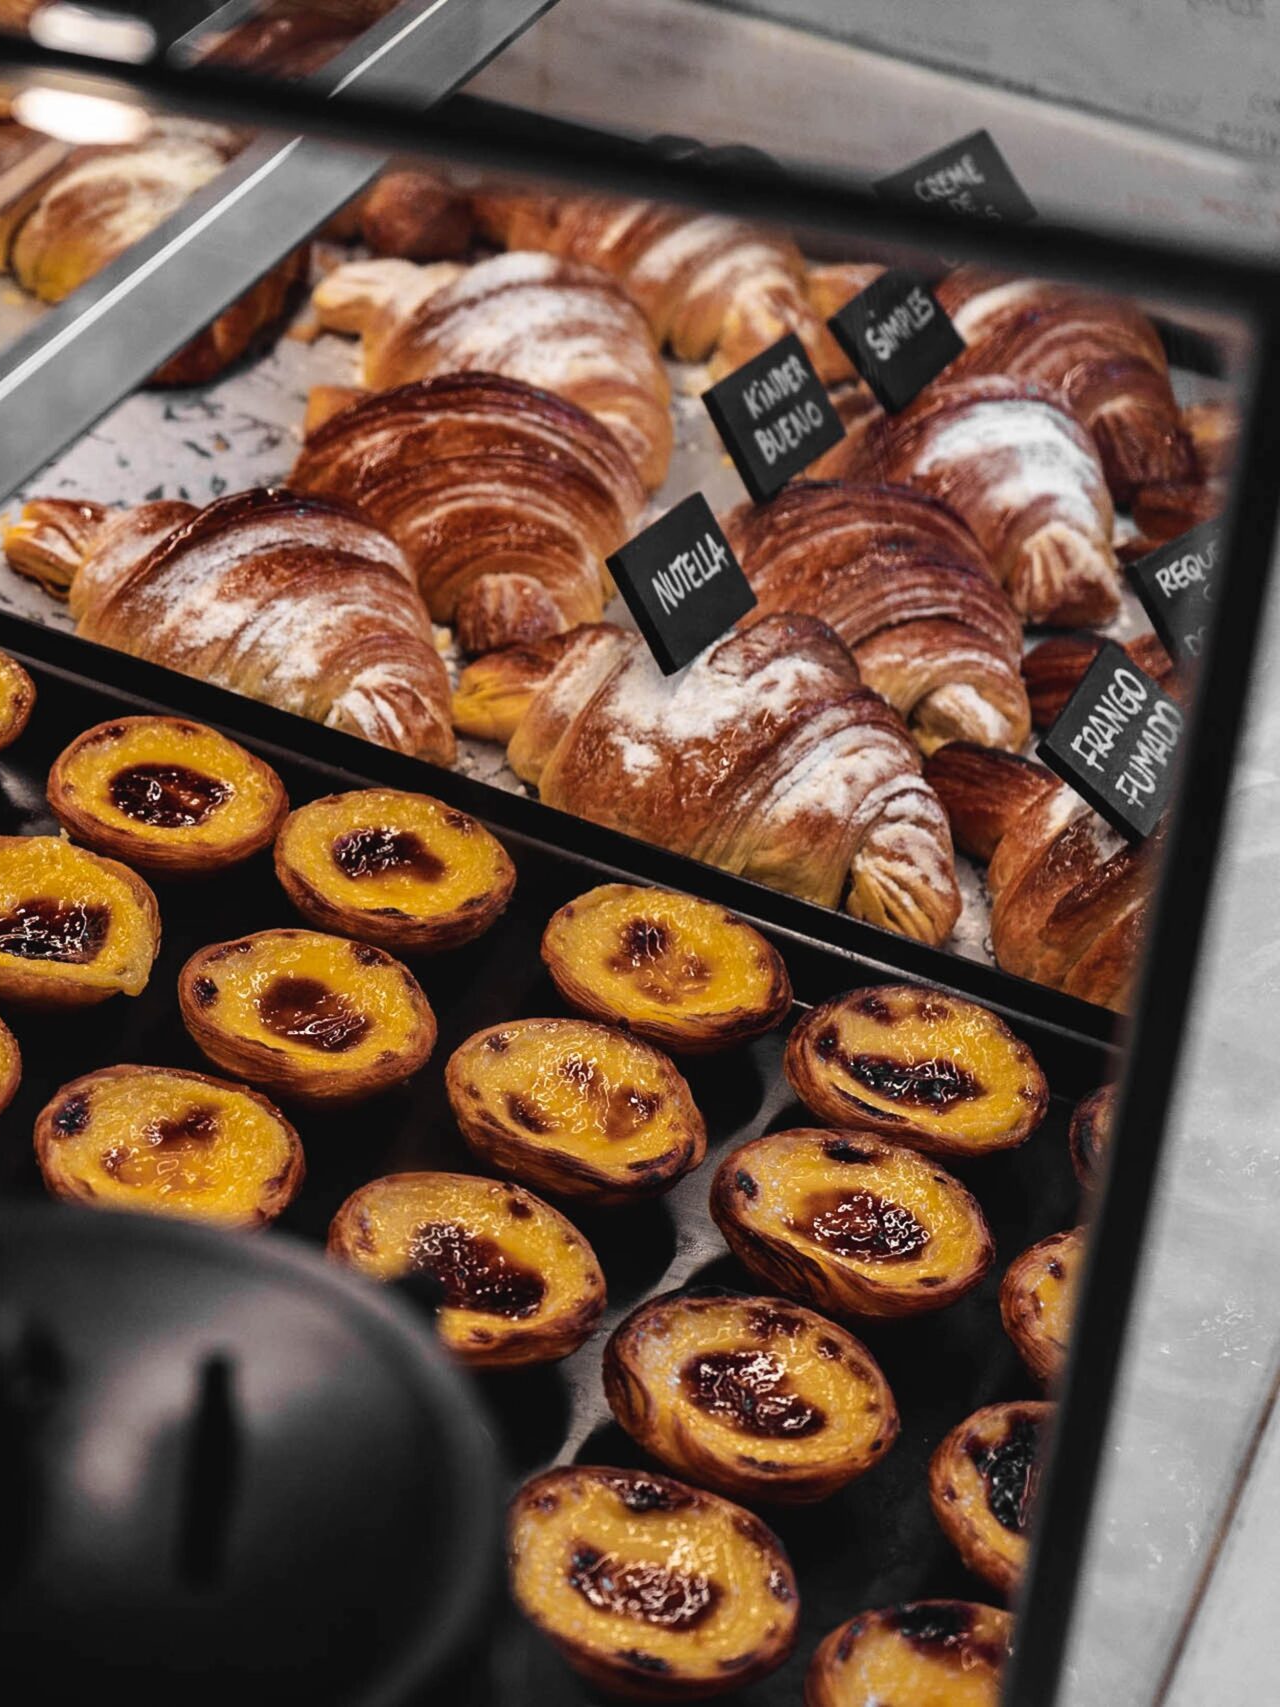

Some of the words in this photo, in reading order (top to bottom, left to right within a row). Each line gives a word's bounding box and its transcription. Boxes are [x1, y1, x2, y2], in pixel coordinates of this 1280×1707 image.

[753, 400, 824, 465] BUENO
[651, 532, 730, 616] NUTELLA
[1070, 667, 1148, 773] FRANGO
[1114, 699, 1184, 809] FUMADO
